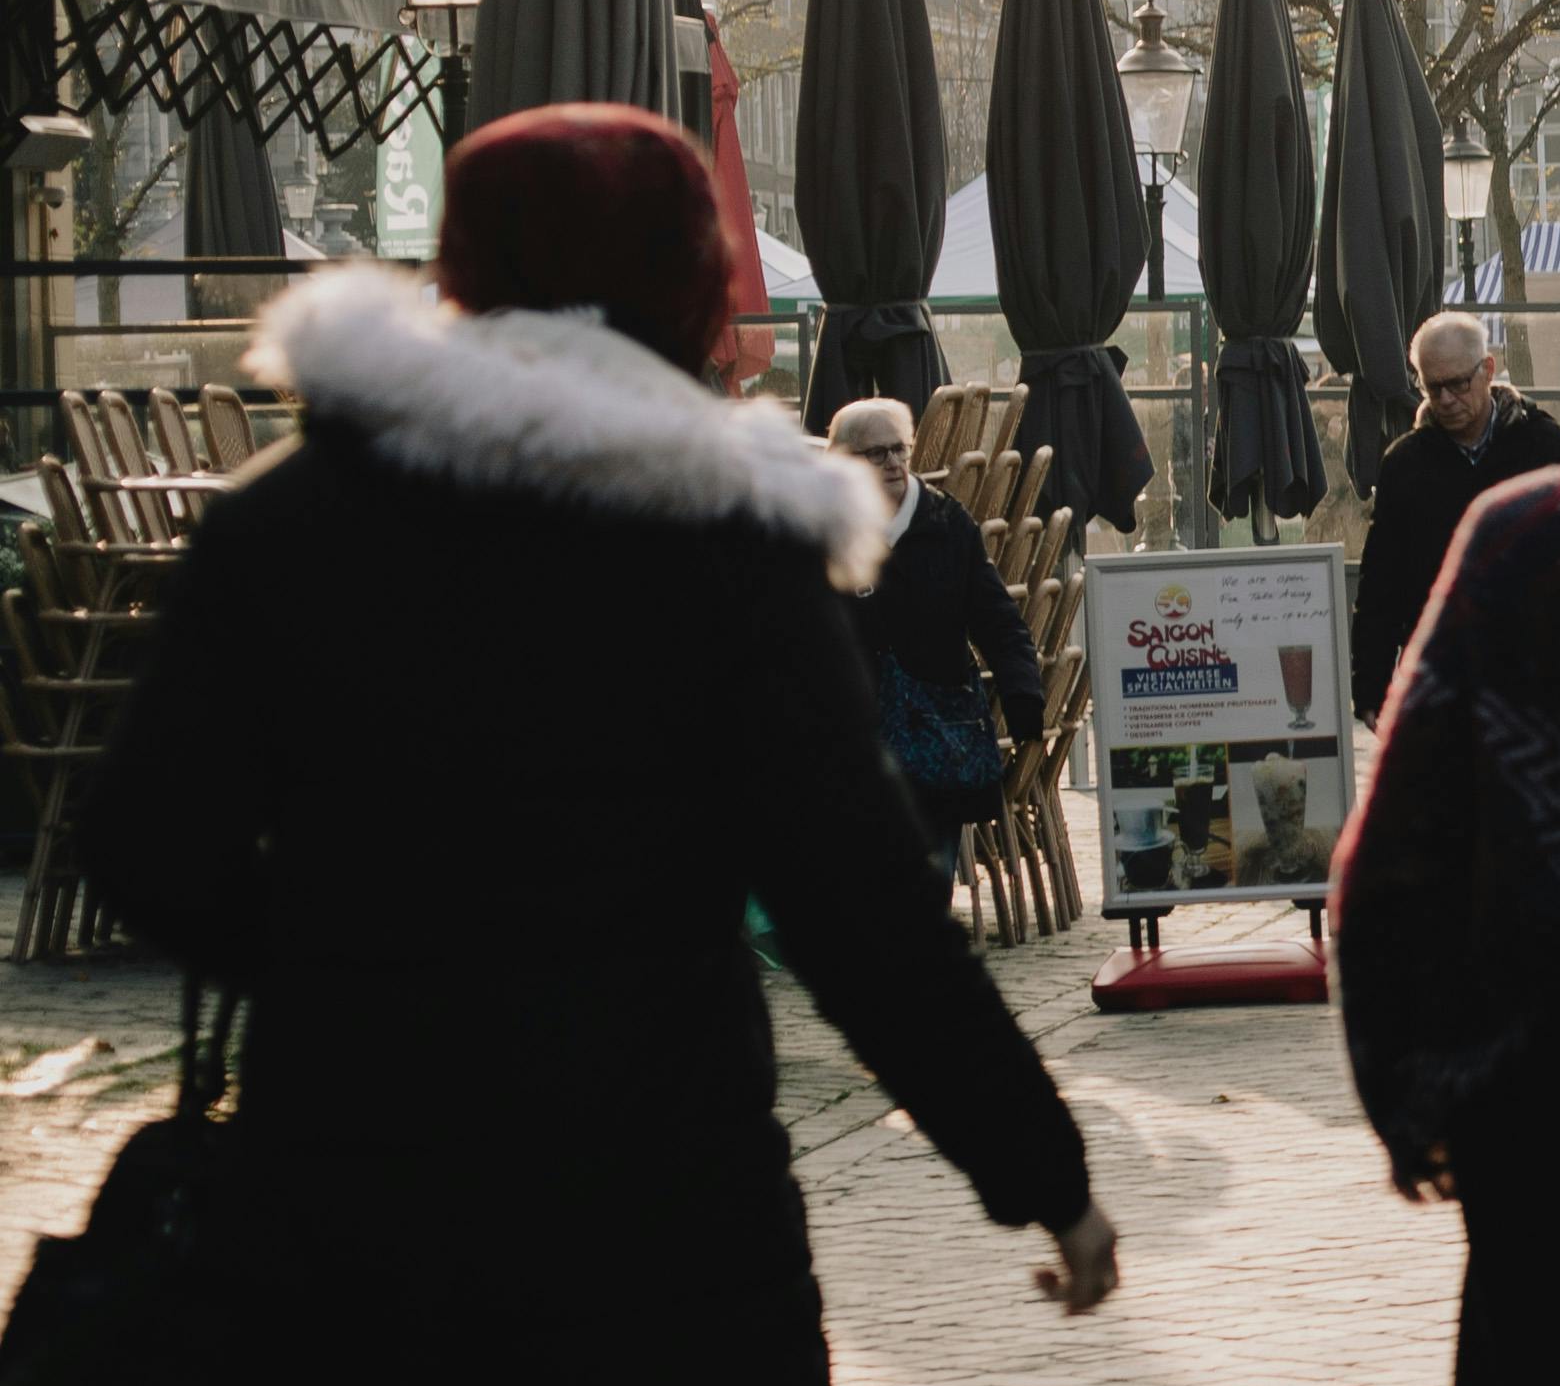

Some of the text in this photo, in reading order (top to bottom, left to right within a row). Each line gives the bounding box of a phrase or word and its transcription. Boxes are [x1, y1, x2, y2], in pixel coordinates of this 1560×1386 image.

[1146, 643, 1232, 671] CUISINE
[1136, 668, 1221, 683] VIETNAMESE
[1127, 677, 1232, 694] SPECIALITEITEN
